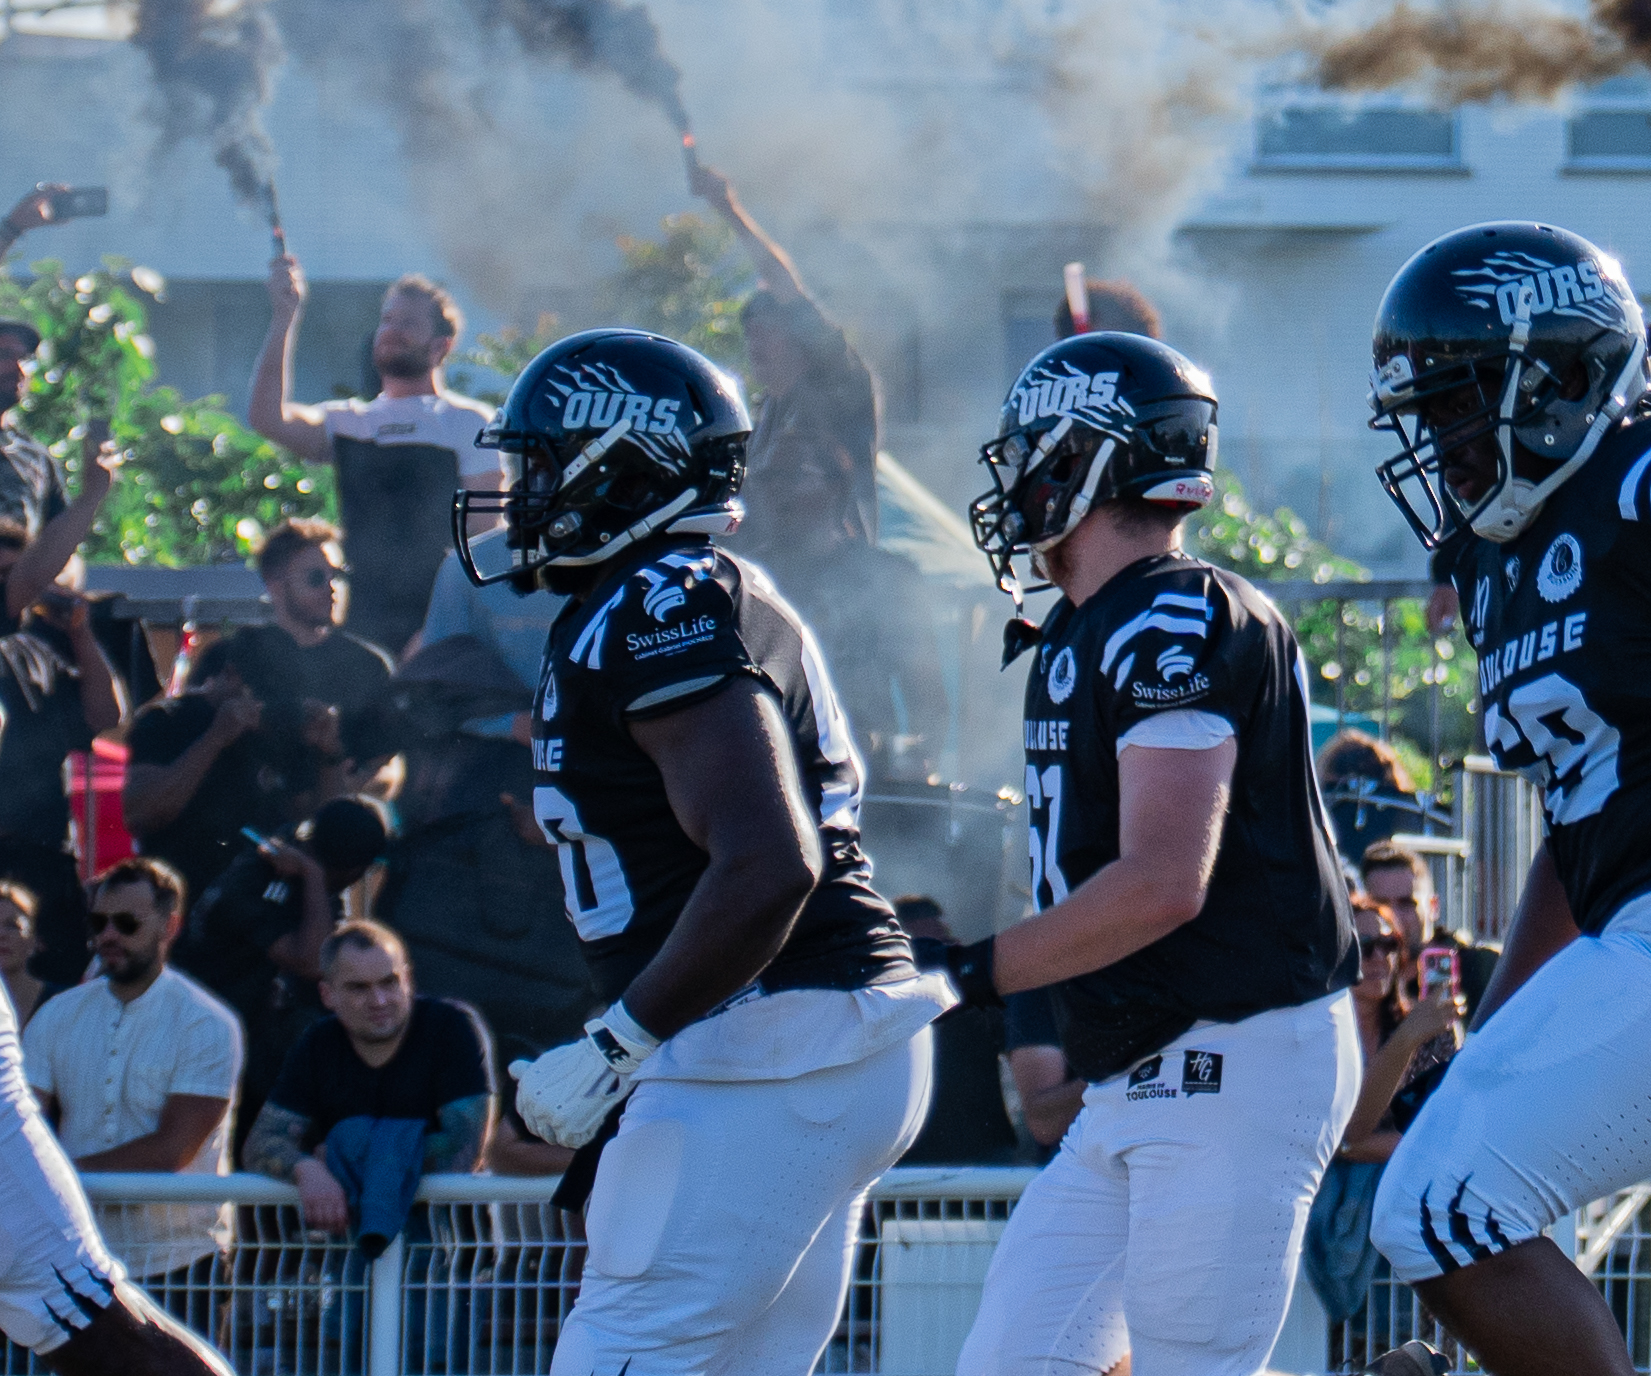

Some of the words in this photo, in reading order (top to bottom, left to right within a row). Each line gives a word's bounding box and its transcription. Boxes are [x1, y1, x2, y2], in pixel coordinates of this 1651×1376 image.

[1496, 258, 1604, 326] OURS
[562, 391, 681, 435] OURS
[1017, 370, 1119, 426] OURS
[1479, 611, 1587, 697] OULOUSE
[1126, 1089, 1177, 1101] TOULOUSE
